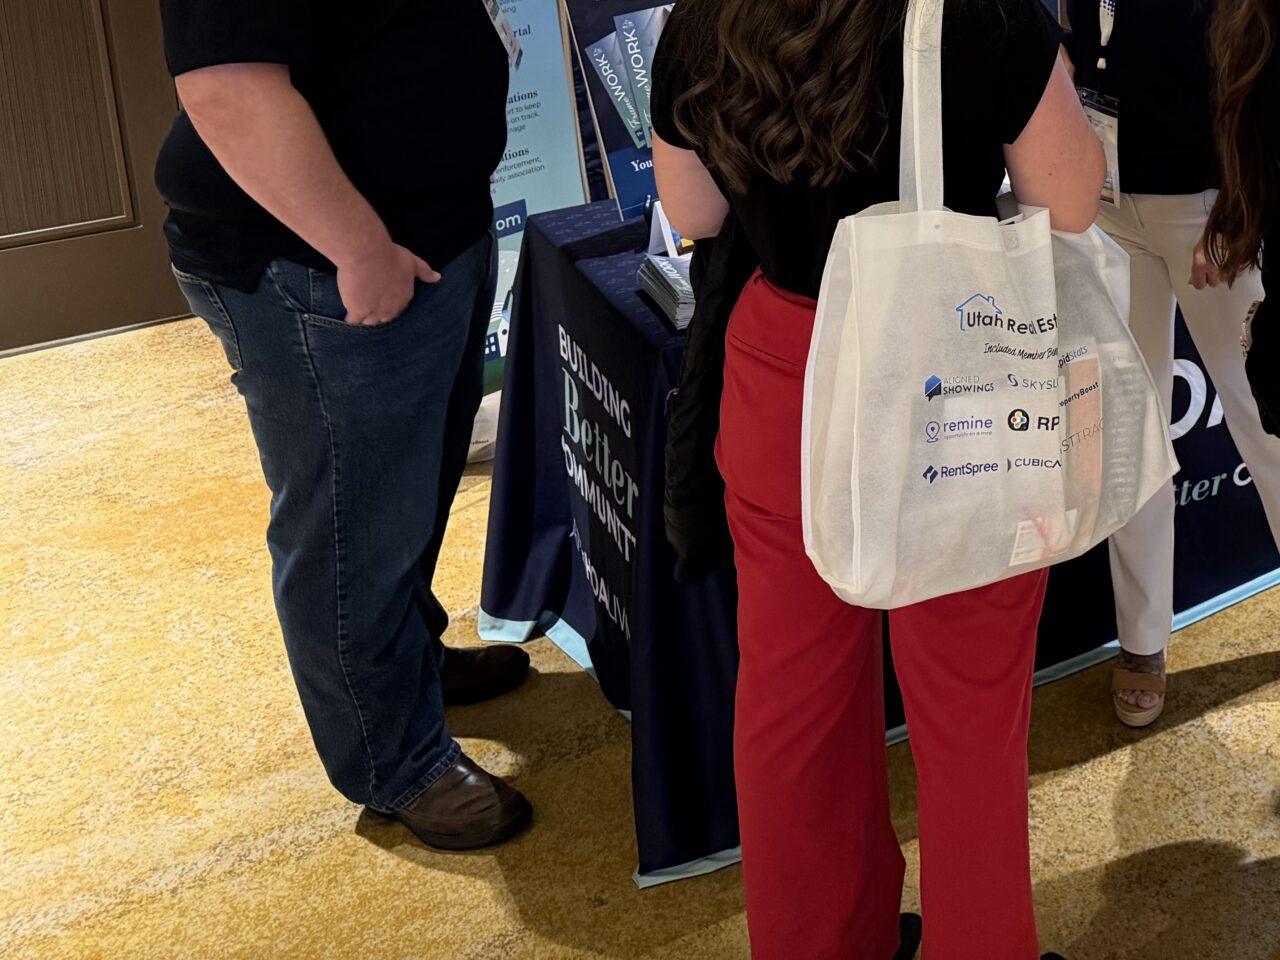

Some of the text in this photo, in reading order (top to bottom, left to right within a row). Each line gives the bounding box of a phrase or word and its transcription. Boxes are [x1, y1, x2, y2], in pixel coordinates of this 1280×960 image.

[966, 311, 1003, 328] Utah
[984, 342, 1016, 356] Included
[1016, 349, 1046, 361] Member
[943, 375, 980, 385] ALIGNED
[943, 382, 995, 396] SHOWINGS
[1059, 381, 1099, 407] opertyBoost
[943, 415, 993, 433] remine
[561, 366, 639, 519] Better
[940, 462, 999, 479] RentSpree
